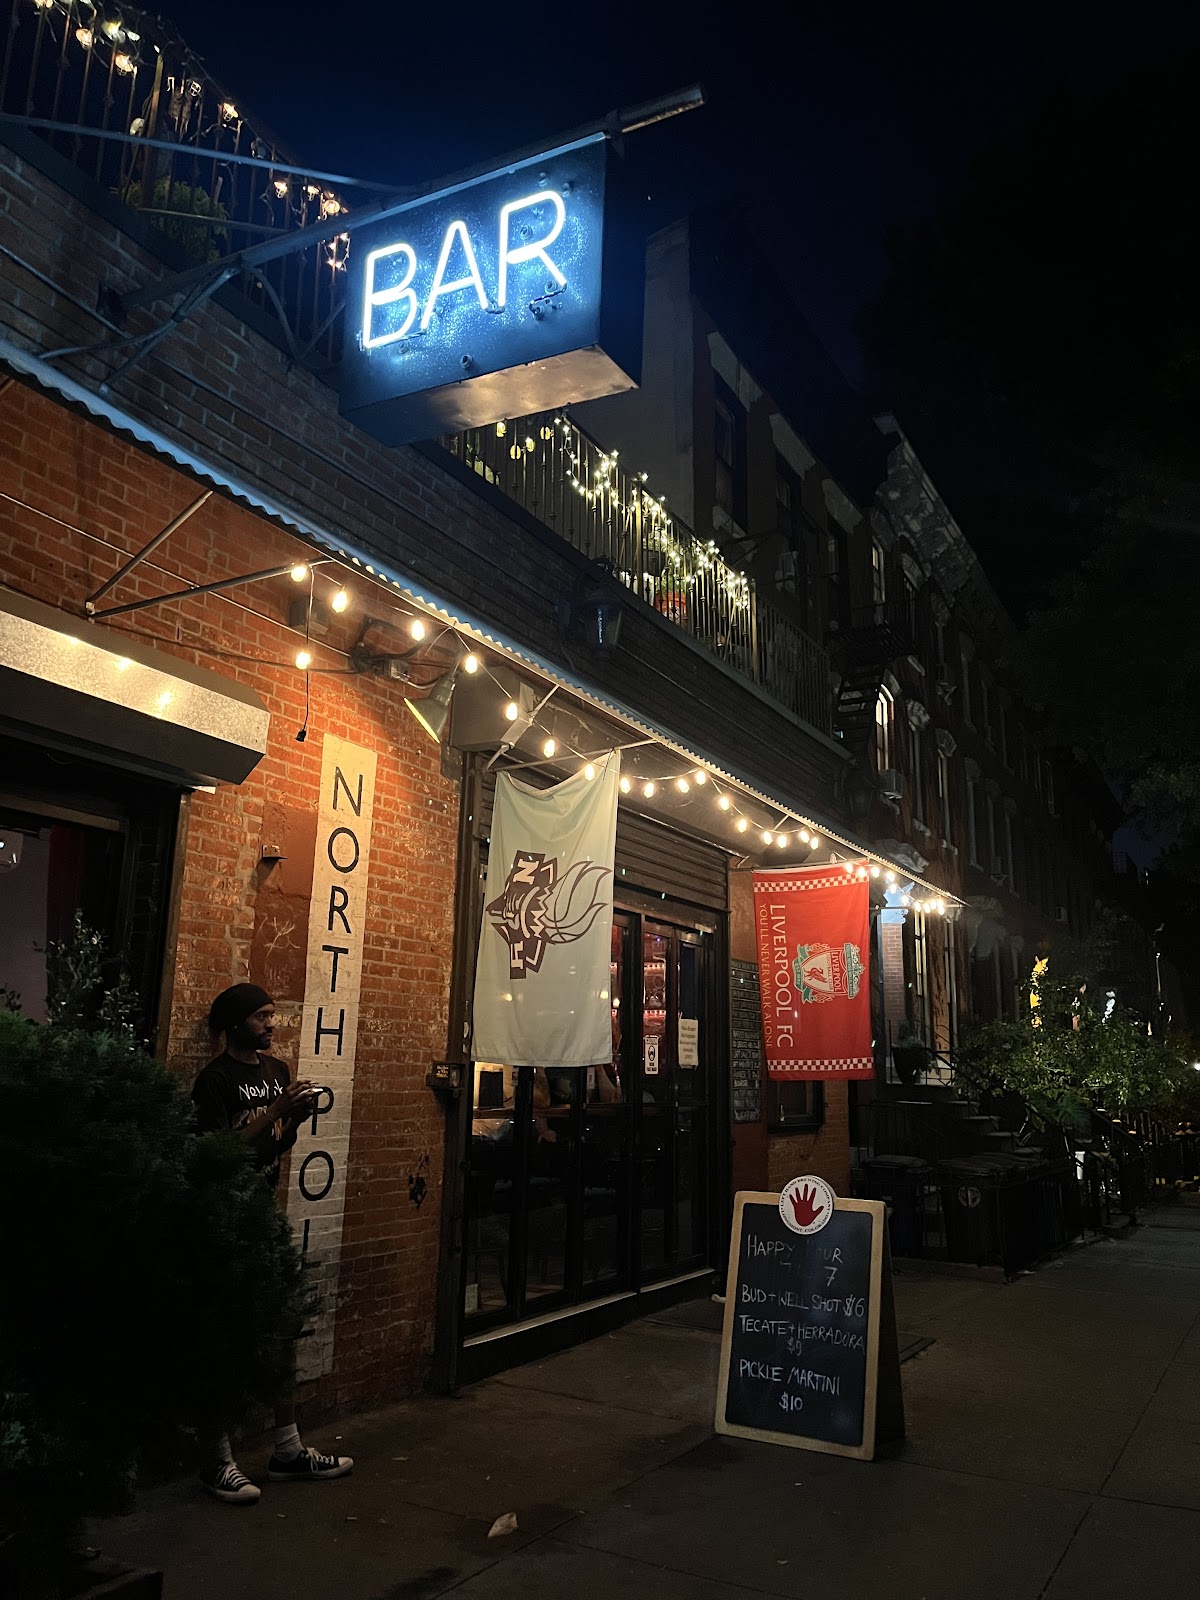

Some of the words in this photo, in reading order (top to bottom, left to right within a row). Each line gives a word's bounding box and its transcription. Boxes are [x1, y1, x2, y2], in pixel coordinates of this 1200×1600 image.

[362, 190, 568, 349] BAR
[512, 858, 539, 885] N
[313, 765, 365, 1058] NORTH
[759, 903, 769, 941] YOU'LL
[760, 943, 771, 976] NEVER
[769, 904, 792, 1018] LIVERPOOL
[831, 952, 842, 992] LIVERPOOL
[761, 978, 772, 1009] WALK
[763, 1012, 772, 1049] ALONE
[776, 1024, 793, 1048] FC
[747, 1233, 794, 1259] HAPPY
[811, 1293, 842, 1313] SHOT
[843, 1293, 865, 1318] $6
[786, 1335, 802, 1357] $9
[739, 1358, 784, 1382] PICKLE
[786, 1366, 841, 1396] MARTINI
[778, 1391, 804, 1412] $10
